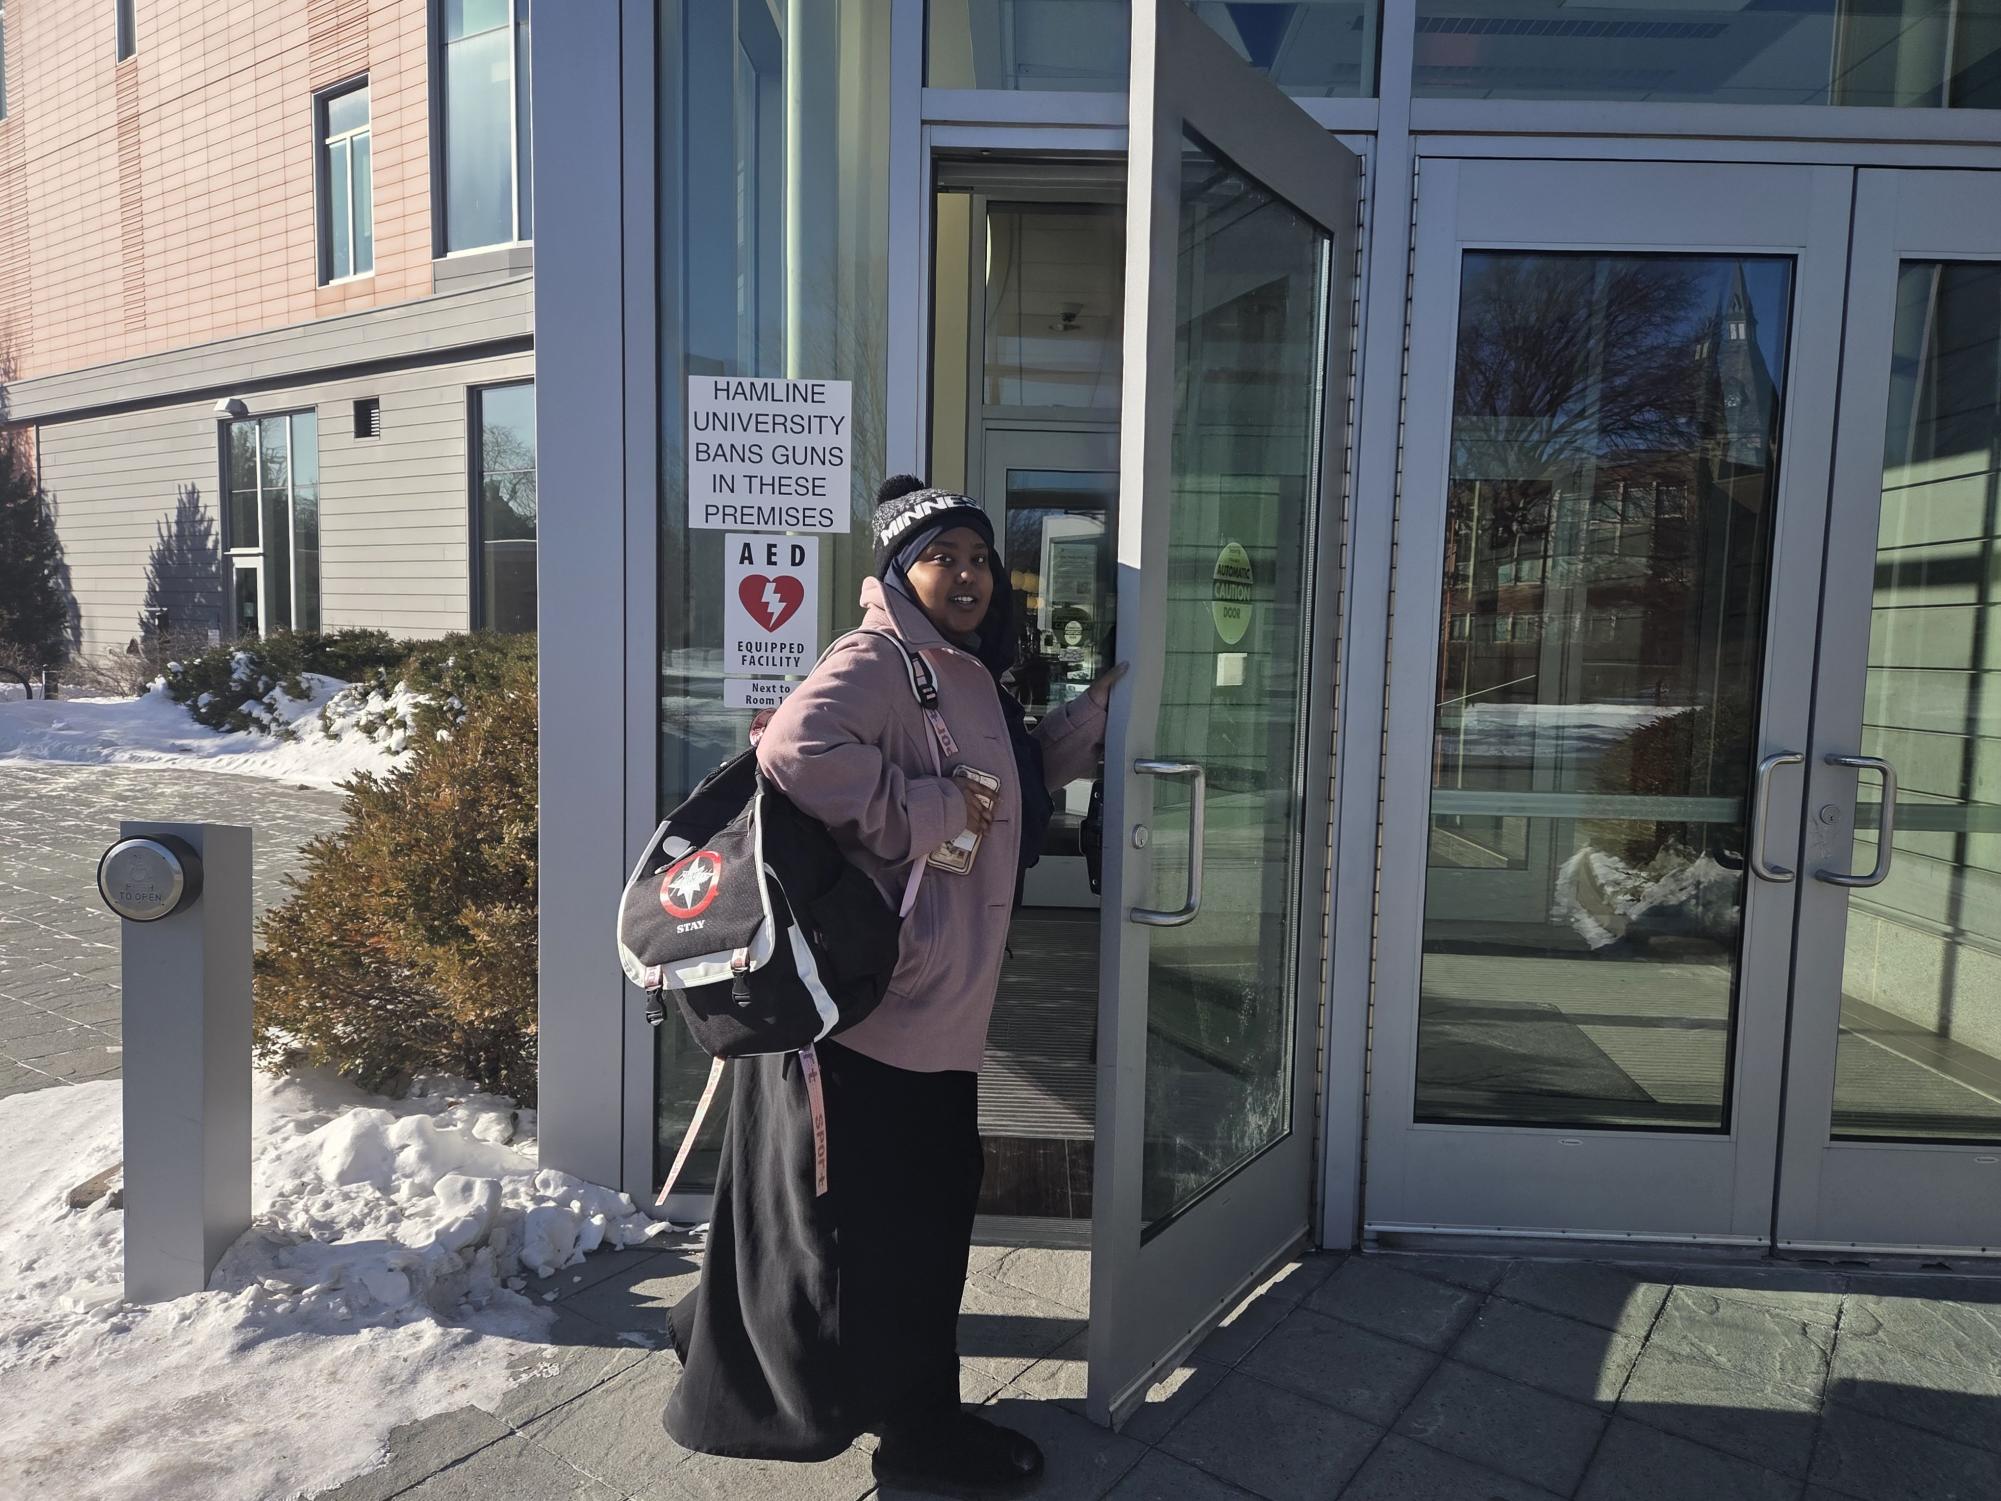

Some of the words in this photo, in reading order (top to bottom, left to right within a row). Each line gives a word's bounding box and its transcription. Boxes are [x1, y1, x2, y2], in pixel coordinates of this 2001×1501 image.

[713, 380, 826, 404] HAMLINE
[693, 411, 845, 436] UNIVERSITY
[695, 442, 763, 464] BANS
[771, 444, 844, 467] GUNS
[712, 474, 735, 494] IN
[743, 475, 827, 497] THESE
[704, 504, 834, 528] PREMISES
[1216, 564, 1250, 579] AUTOMATIC
[1215, 582, 1249, 601] CAUTION
[1223, 606, 1241, 619] DOOR
[737, 641, 805, 654] EQUIPPED
[741, 655, 801, 668] FACILITY
[752, 683, 776, 693] Next
[779, 685, 791, 694] to
[745, 695, 775, 705] Room
[119, 892, 132, 901] TO
[134, 893, 161, 902] OPEN
[676, 919, 706, 934] STAY
